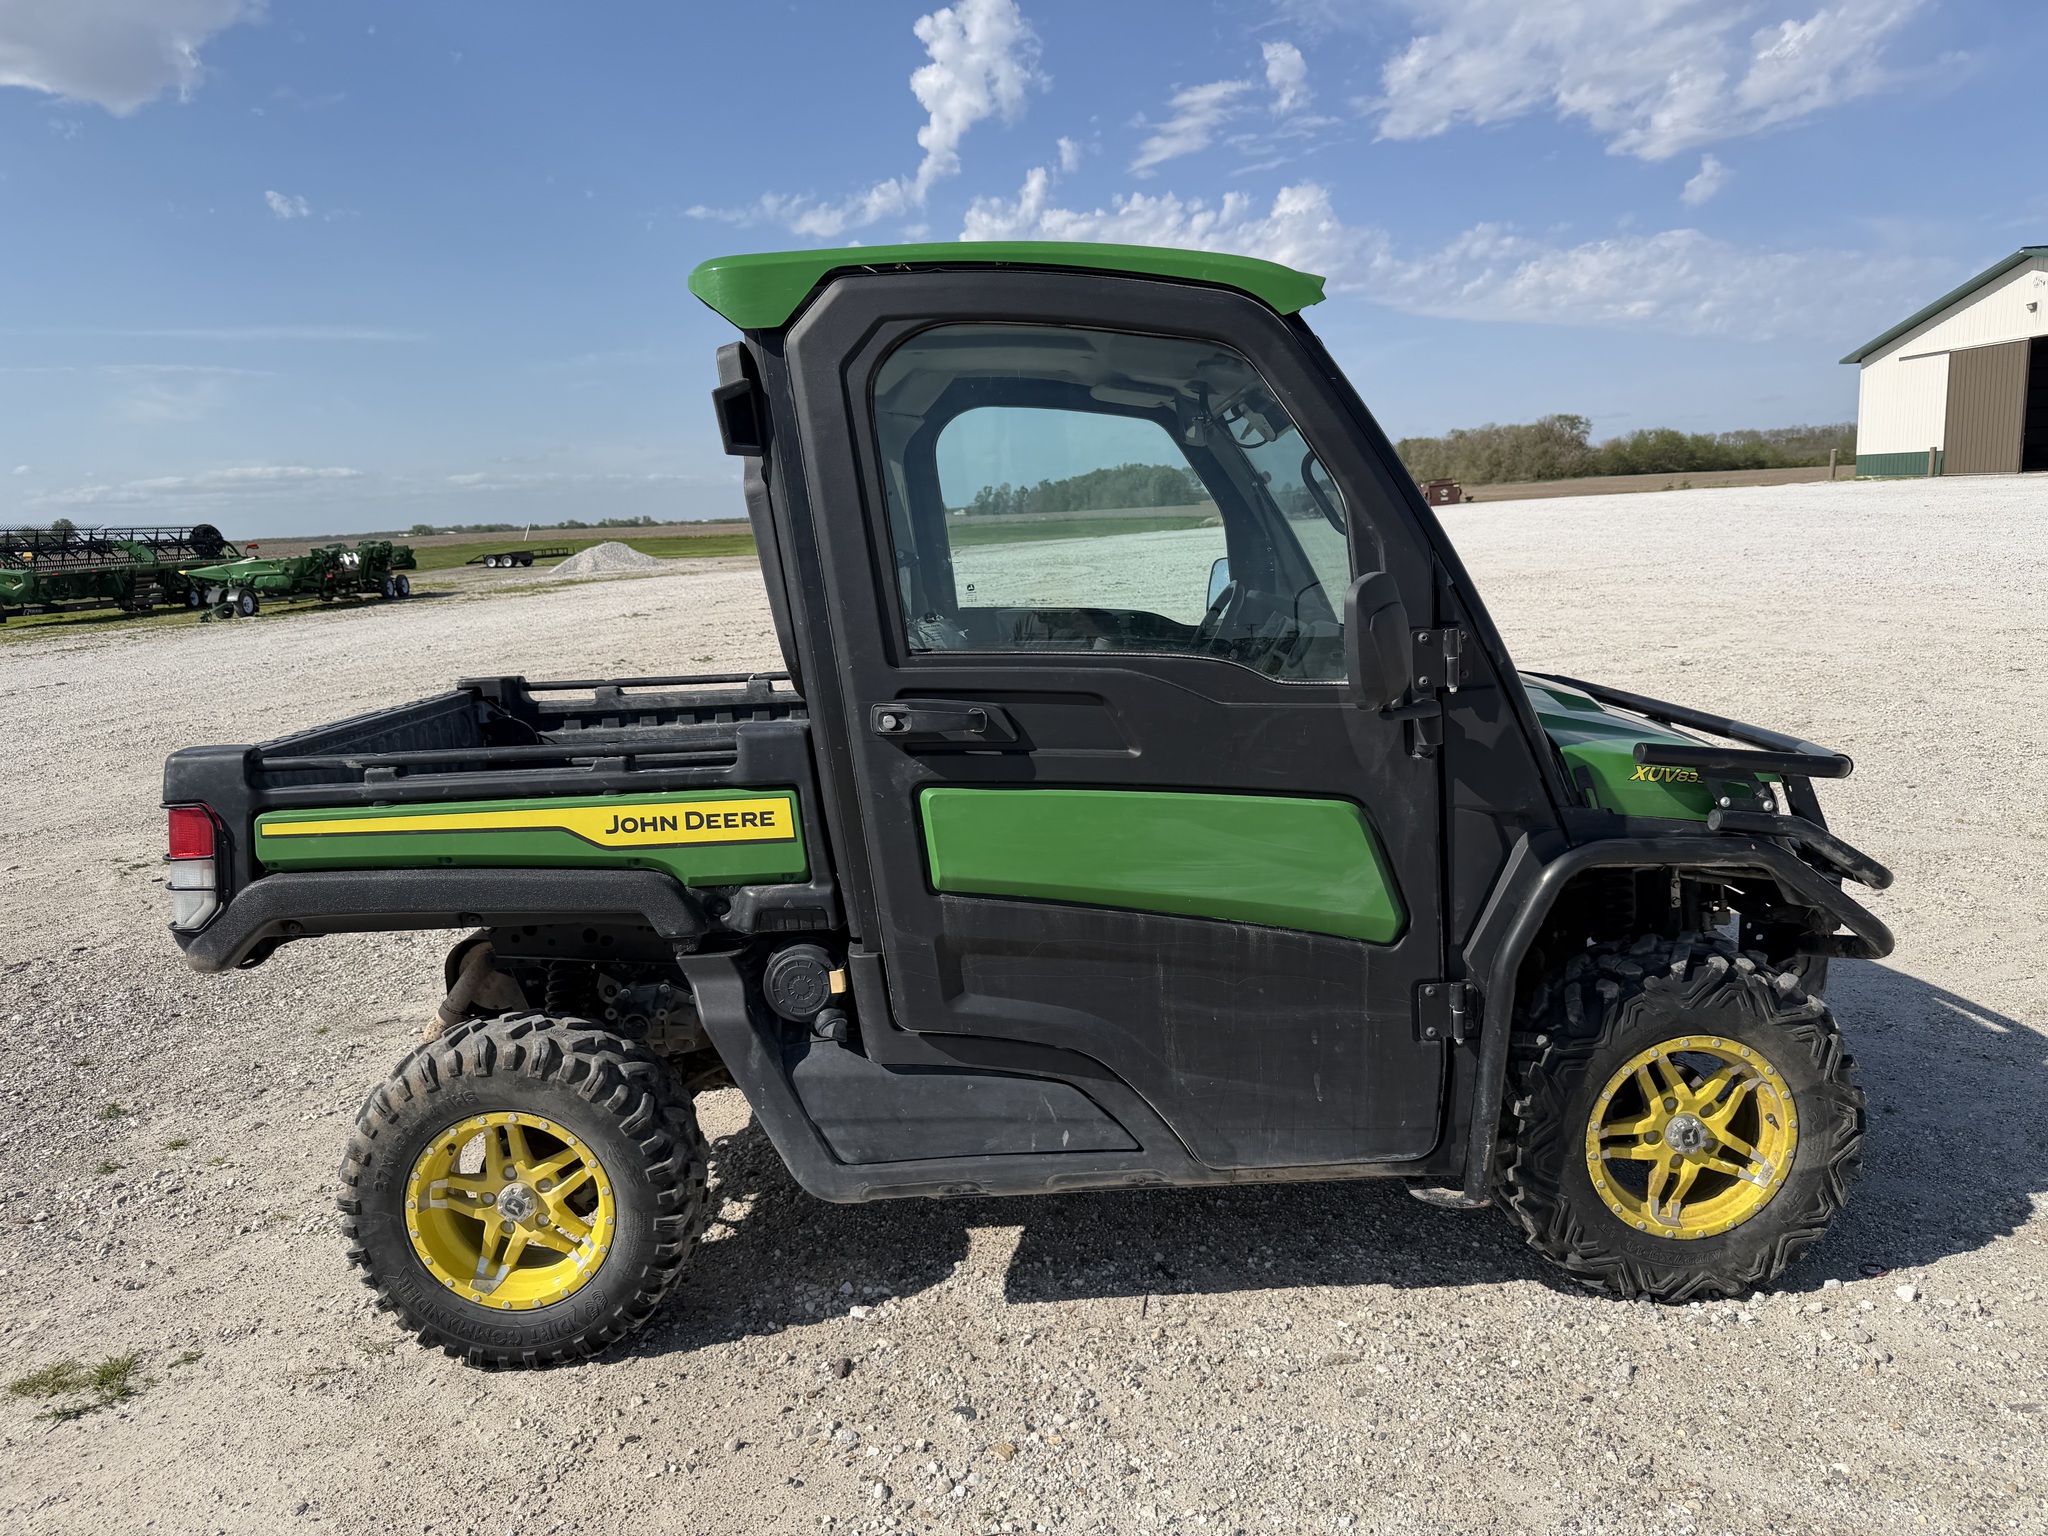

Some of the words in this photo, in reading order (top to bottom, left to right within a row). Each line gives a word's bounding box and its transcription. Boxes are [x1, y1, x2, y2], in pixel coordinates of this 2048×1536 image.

[605, 815, 678, 835] JOHN
[684, 811, 776, 831] DEERE
[530, 1316, 576, 1344] DIRT
